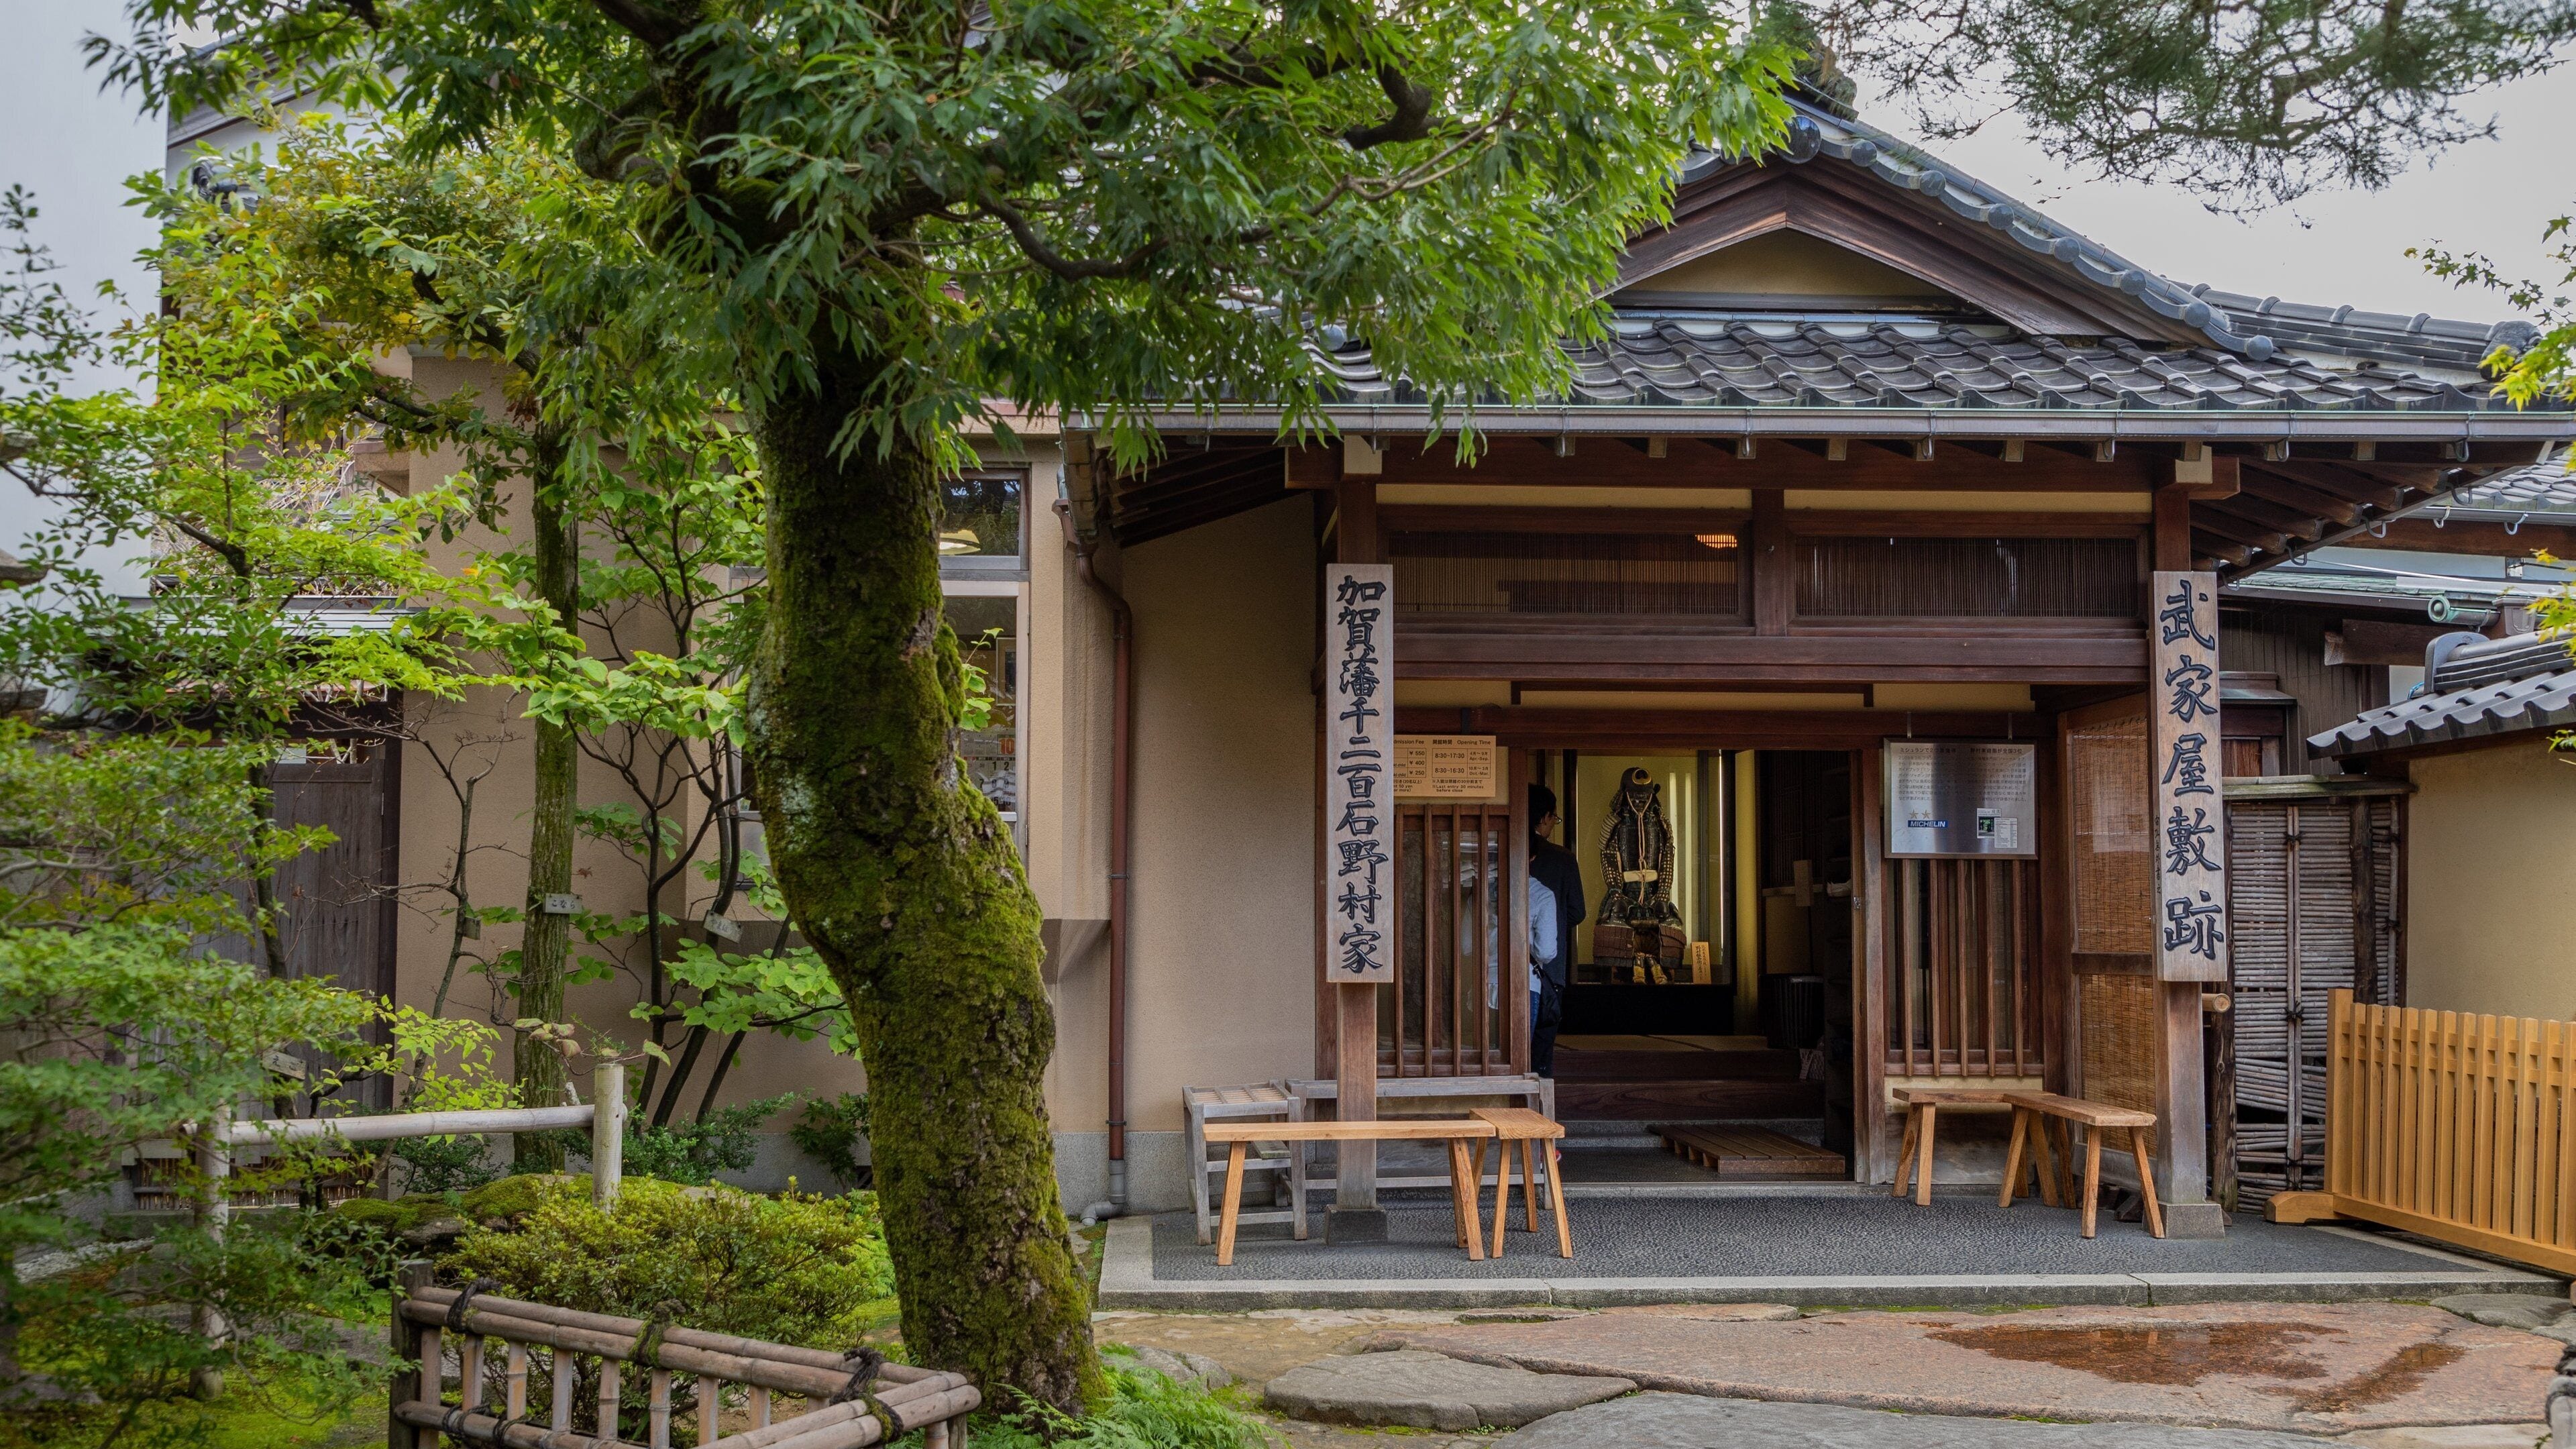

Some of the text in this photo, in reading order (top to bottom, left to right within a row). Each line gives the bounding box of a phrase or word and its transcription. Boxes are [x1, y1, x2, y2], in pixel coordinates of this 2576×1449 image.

[1000, 739, 1014, 755] 10
[992, 761, 997, 771] 1
[1004, 761, 1010, 771] 2
[2160, 580, 2225, 961] 武家屋敷跡
[1336, 575, 1389, 974] 加賀藩千二百石野村家
[551, 900, 575, 909] こなら
